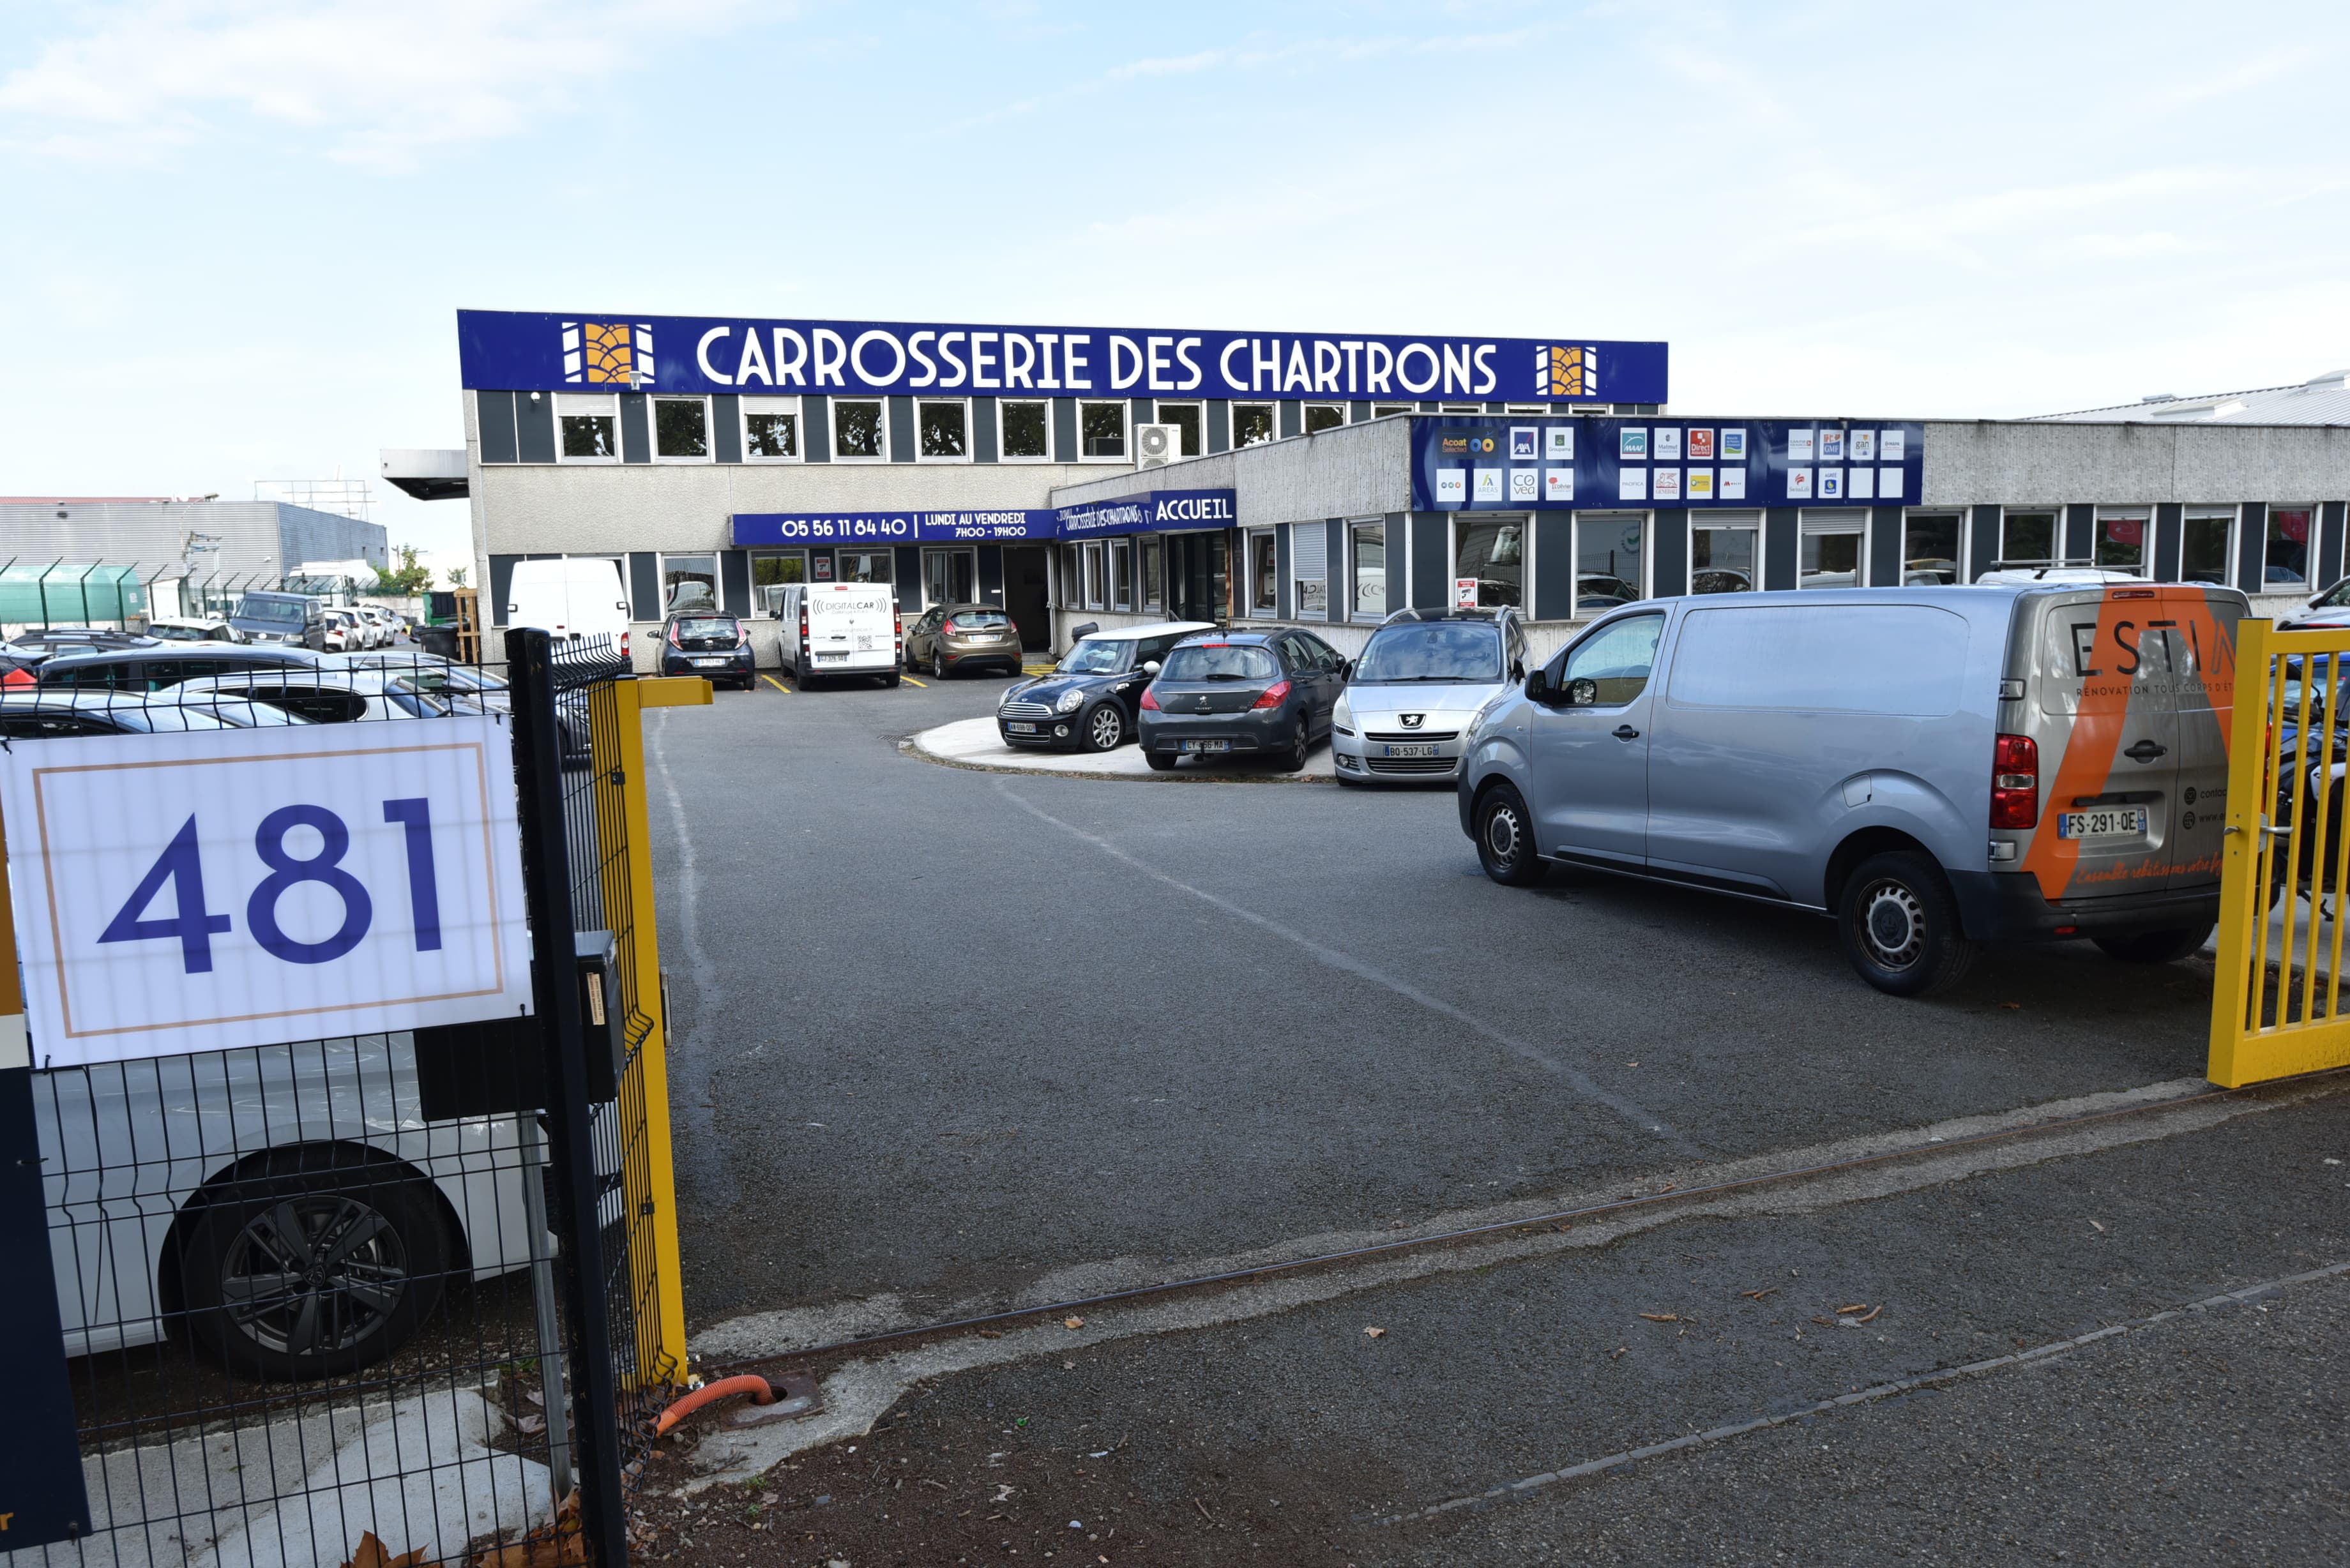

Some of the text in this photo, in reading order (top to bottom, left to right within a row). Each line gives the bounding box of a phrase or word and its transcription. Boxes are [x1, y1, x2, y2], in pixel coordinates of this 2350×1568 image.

[697, 326, 1496, 395] CARROSSERIE DES CHARTRONS
[1443, 438, 1466, 446] Acoat
[1514, 443, 1531, 453] AXA
[1824, 445, 1839, 453] GMF
[1856, 441, 1870, 450] gan
[1156, 499, 1232, 521] ACCUEIL
[925, 513, 1026, 525] LUNDI AU VENDREDI
[1066, 511, 1096, 531] CARROSSERIE
[782, 518, 907, 537] 05 56 11 84 40
[826, 602, 874, 610] DIGITALCAR
[2077, 680, 2233, 697] RÉNOVATION TOUS CORPS D'ÉT
[97, 797, 441, 974] 481
